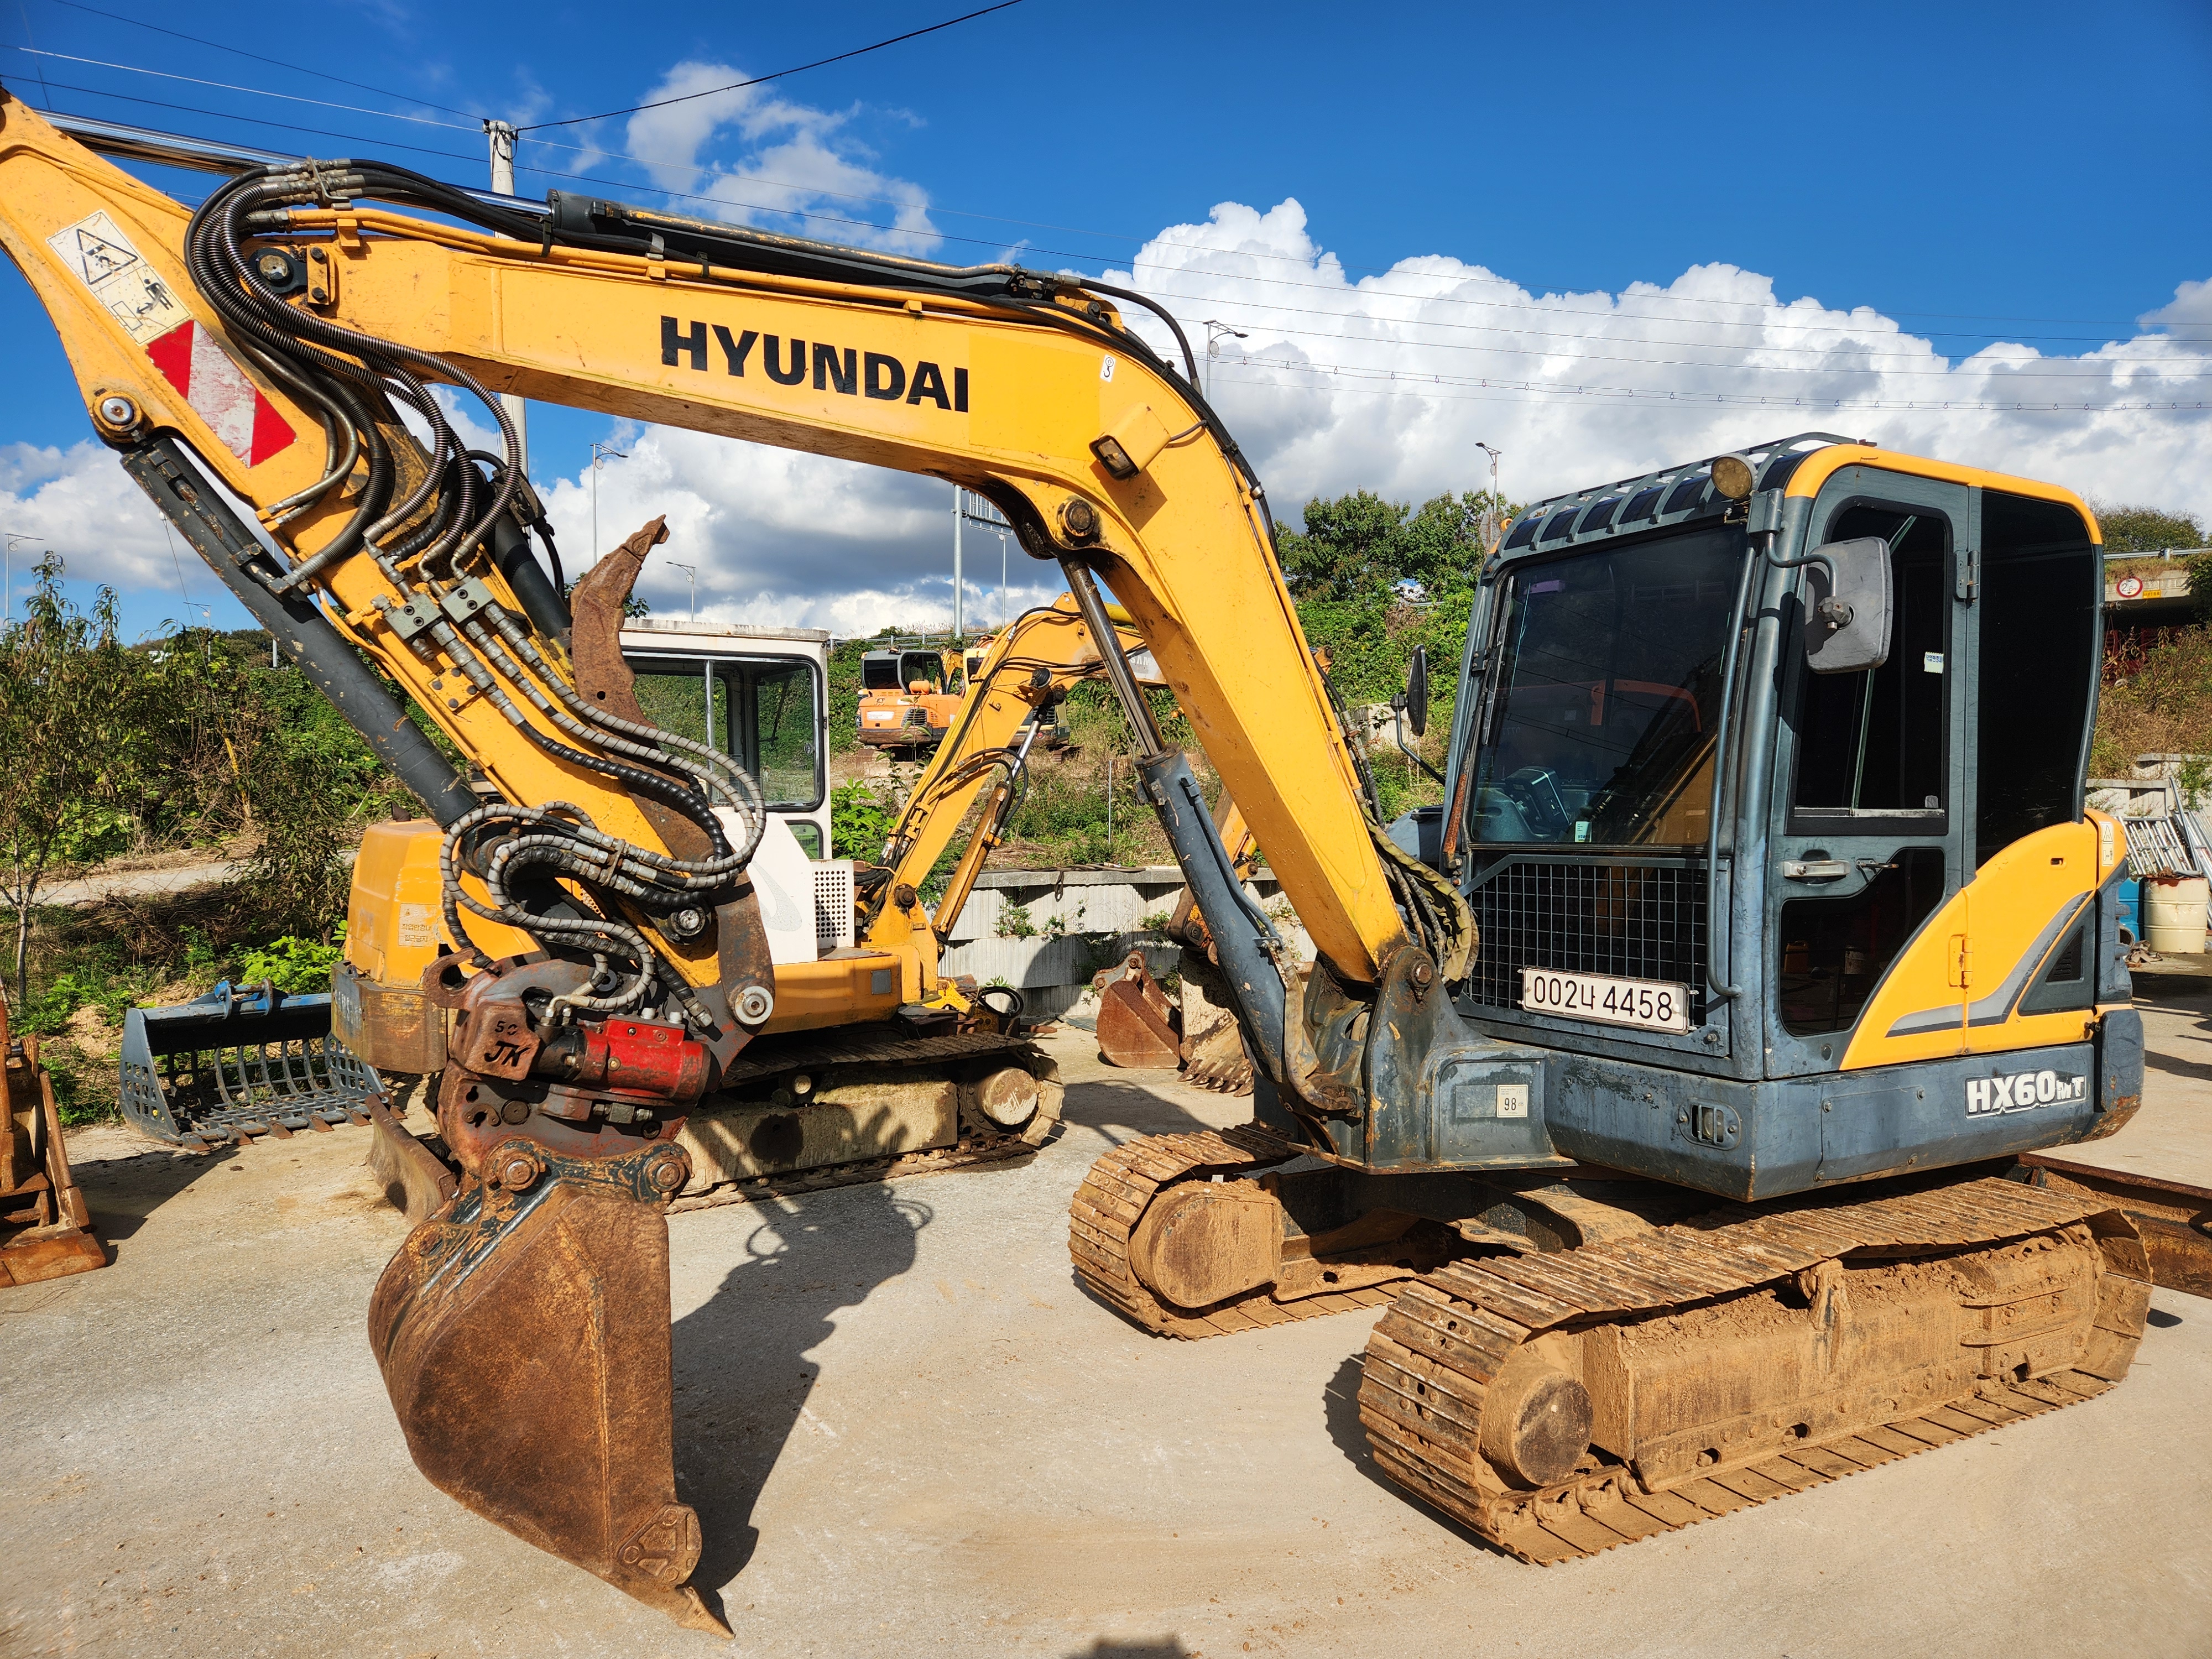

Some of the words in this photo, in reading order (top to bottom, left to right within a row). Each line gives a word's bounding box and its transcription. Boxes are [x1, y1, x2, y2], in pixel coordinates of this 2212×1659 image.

[661, 315, 969, 413] HYUNDAI
[1603, 985, 1672, 1021] 4458
[484, 1040, 531, 1067] JK
[1504, 1098, 1516, 1110] 98
